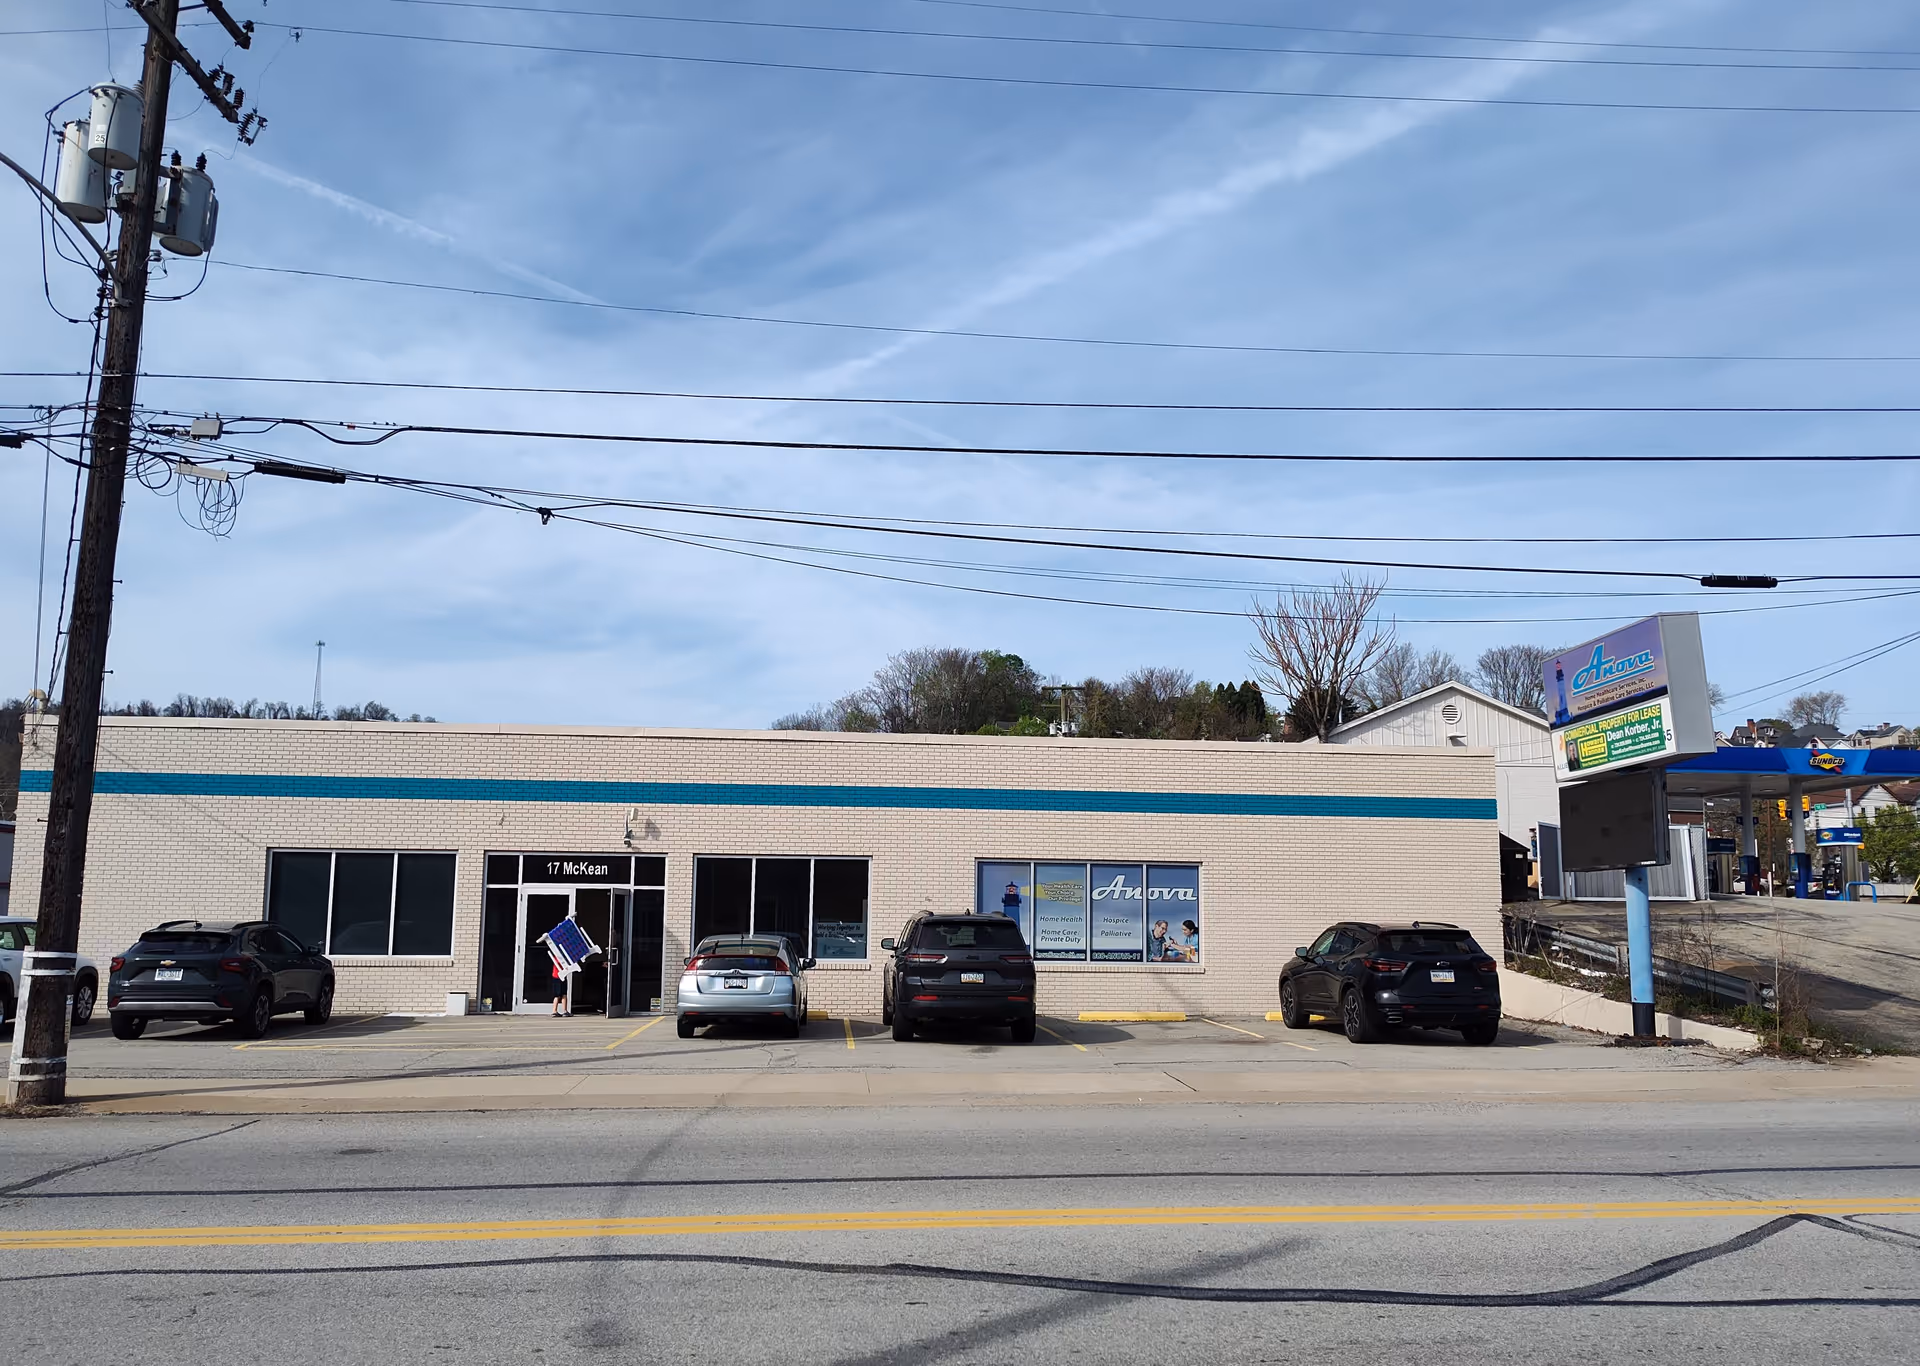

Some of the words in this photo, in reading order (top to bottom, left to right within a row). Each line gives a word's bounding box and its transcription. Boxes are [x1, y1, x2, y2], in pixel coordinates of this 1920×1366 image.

[95, 134, 106, 142] 25
[1572, 642, 1655, 690] Anova
[1645, 681, 1655, 690] LLC
[1564, 722, 1599, 741] COMMERCIAL
[1599, 715, 1628, 731] PROPERTY
[1628, 710, 1640, 723] FOR
[1640, 705, 1661, 720] LEASE
[1606, 729, 1625, 742] Dean
[1624, 722, 1651, 737] Korber,
[1651, 718, 1662, 730] Jr.
[1811, 757, 1844, 765] SUNOCO
[547, 861, 560, 875] 17
[563, 861, 608, 876] McKean
[1092, 874, 1198, 901] Anova
[1060, 915, 1083, 923] Health
[1103, 916, 1129, 925] Hospice
[1100, 929, 1132, 937] Palliative
[1065, 935, 1082, 944] Duty
